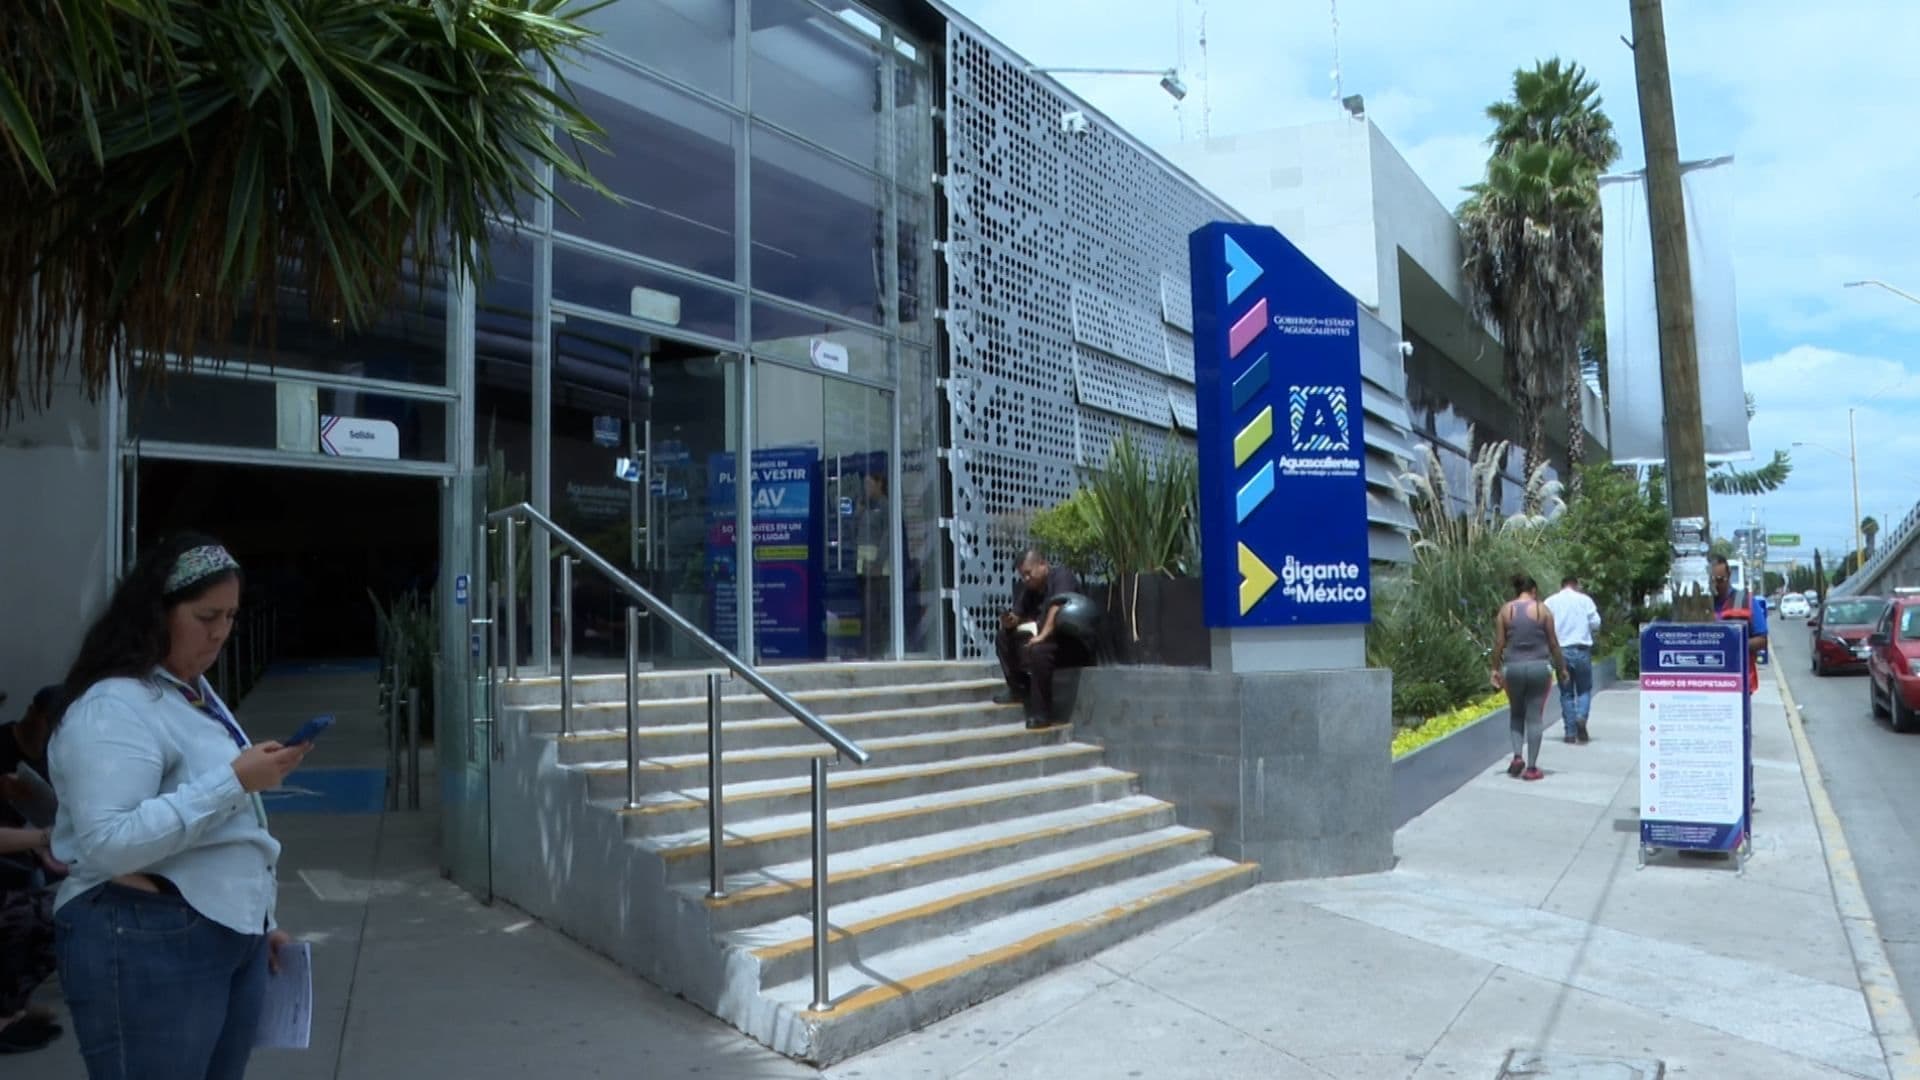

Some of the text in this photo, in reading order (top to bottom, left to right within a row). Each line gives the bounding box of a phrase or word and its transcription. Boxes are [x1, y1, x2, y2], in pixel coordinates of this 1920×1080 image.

[1273, 315, 1317, 325] GOBIERNO
[1324, 317, 1355, 327] ESTADO
[1279, 455, 1360, 470] Aguascalientes
[763, 468, 806, 480] VESTIR
[762, 532, 791, 541] LUGAR
[1282, 560, 1359, 585] gigante
[1282, 582, 1367, 603] de México
[1644, 679, 1737, 689] CAMBIO DE PROPIETARIO
